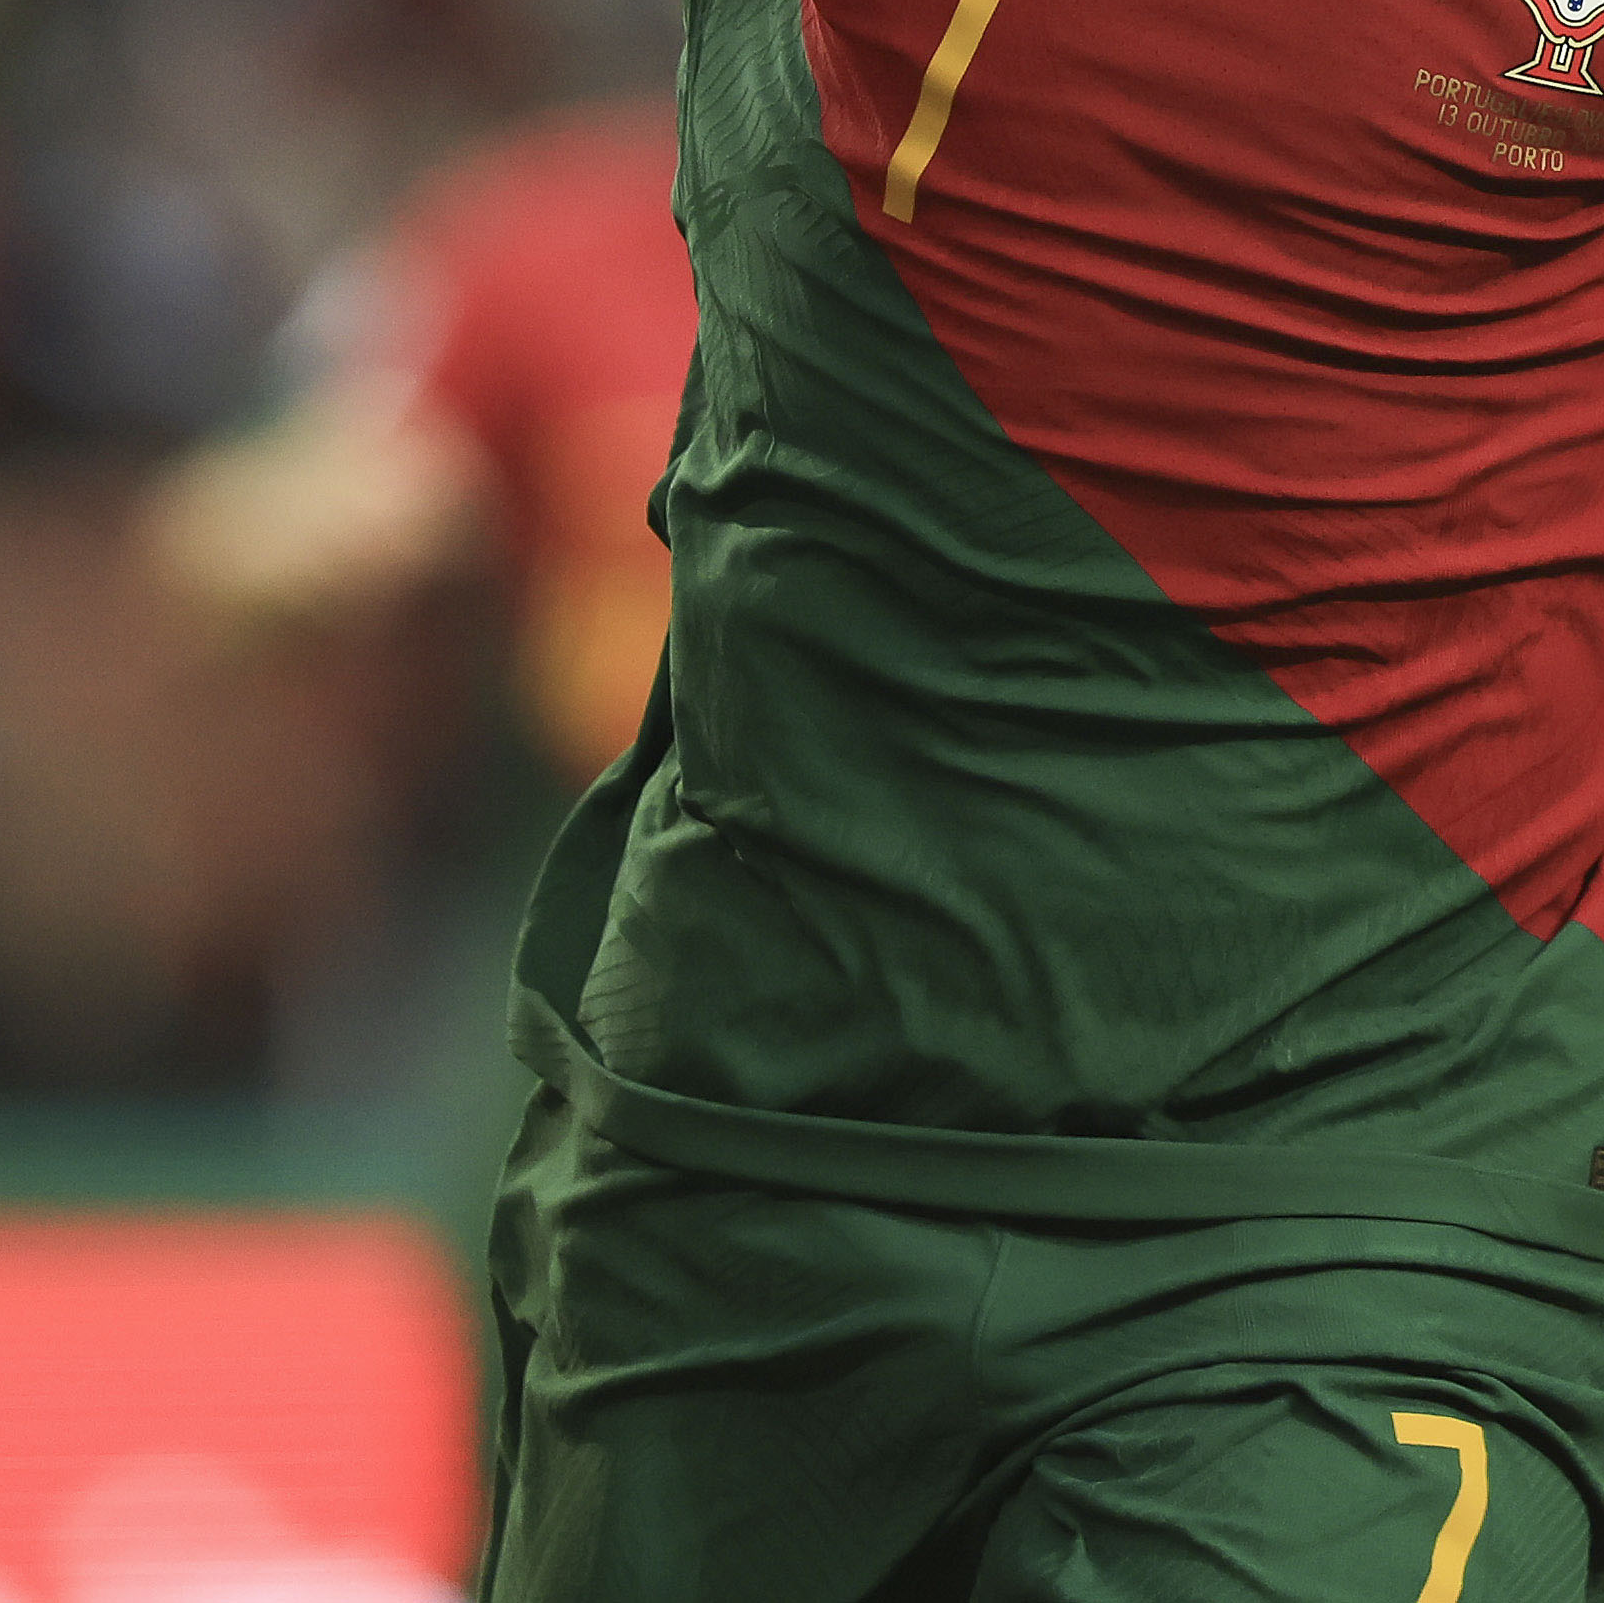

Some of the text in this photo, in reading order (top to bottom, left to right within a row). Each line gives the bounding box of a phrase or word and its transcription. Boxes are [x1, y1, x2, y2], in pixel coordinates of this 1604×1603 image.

[1437, 103, 1459, 127] 13
[1466, 111, 1567, 147] OUTUBRO
[1491, 142, 1564, 172] PORTO
[1390, 1411, 1490, 1603] 7
